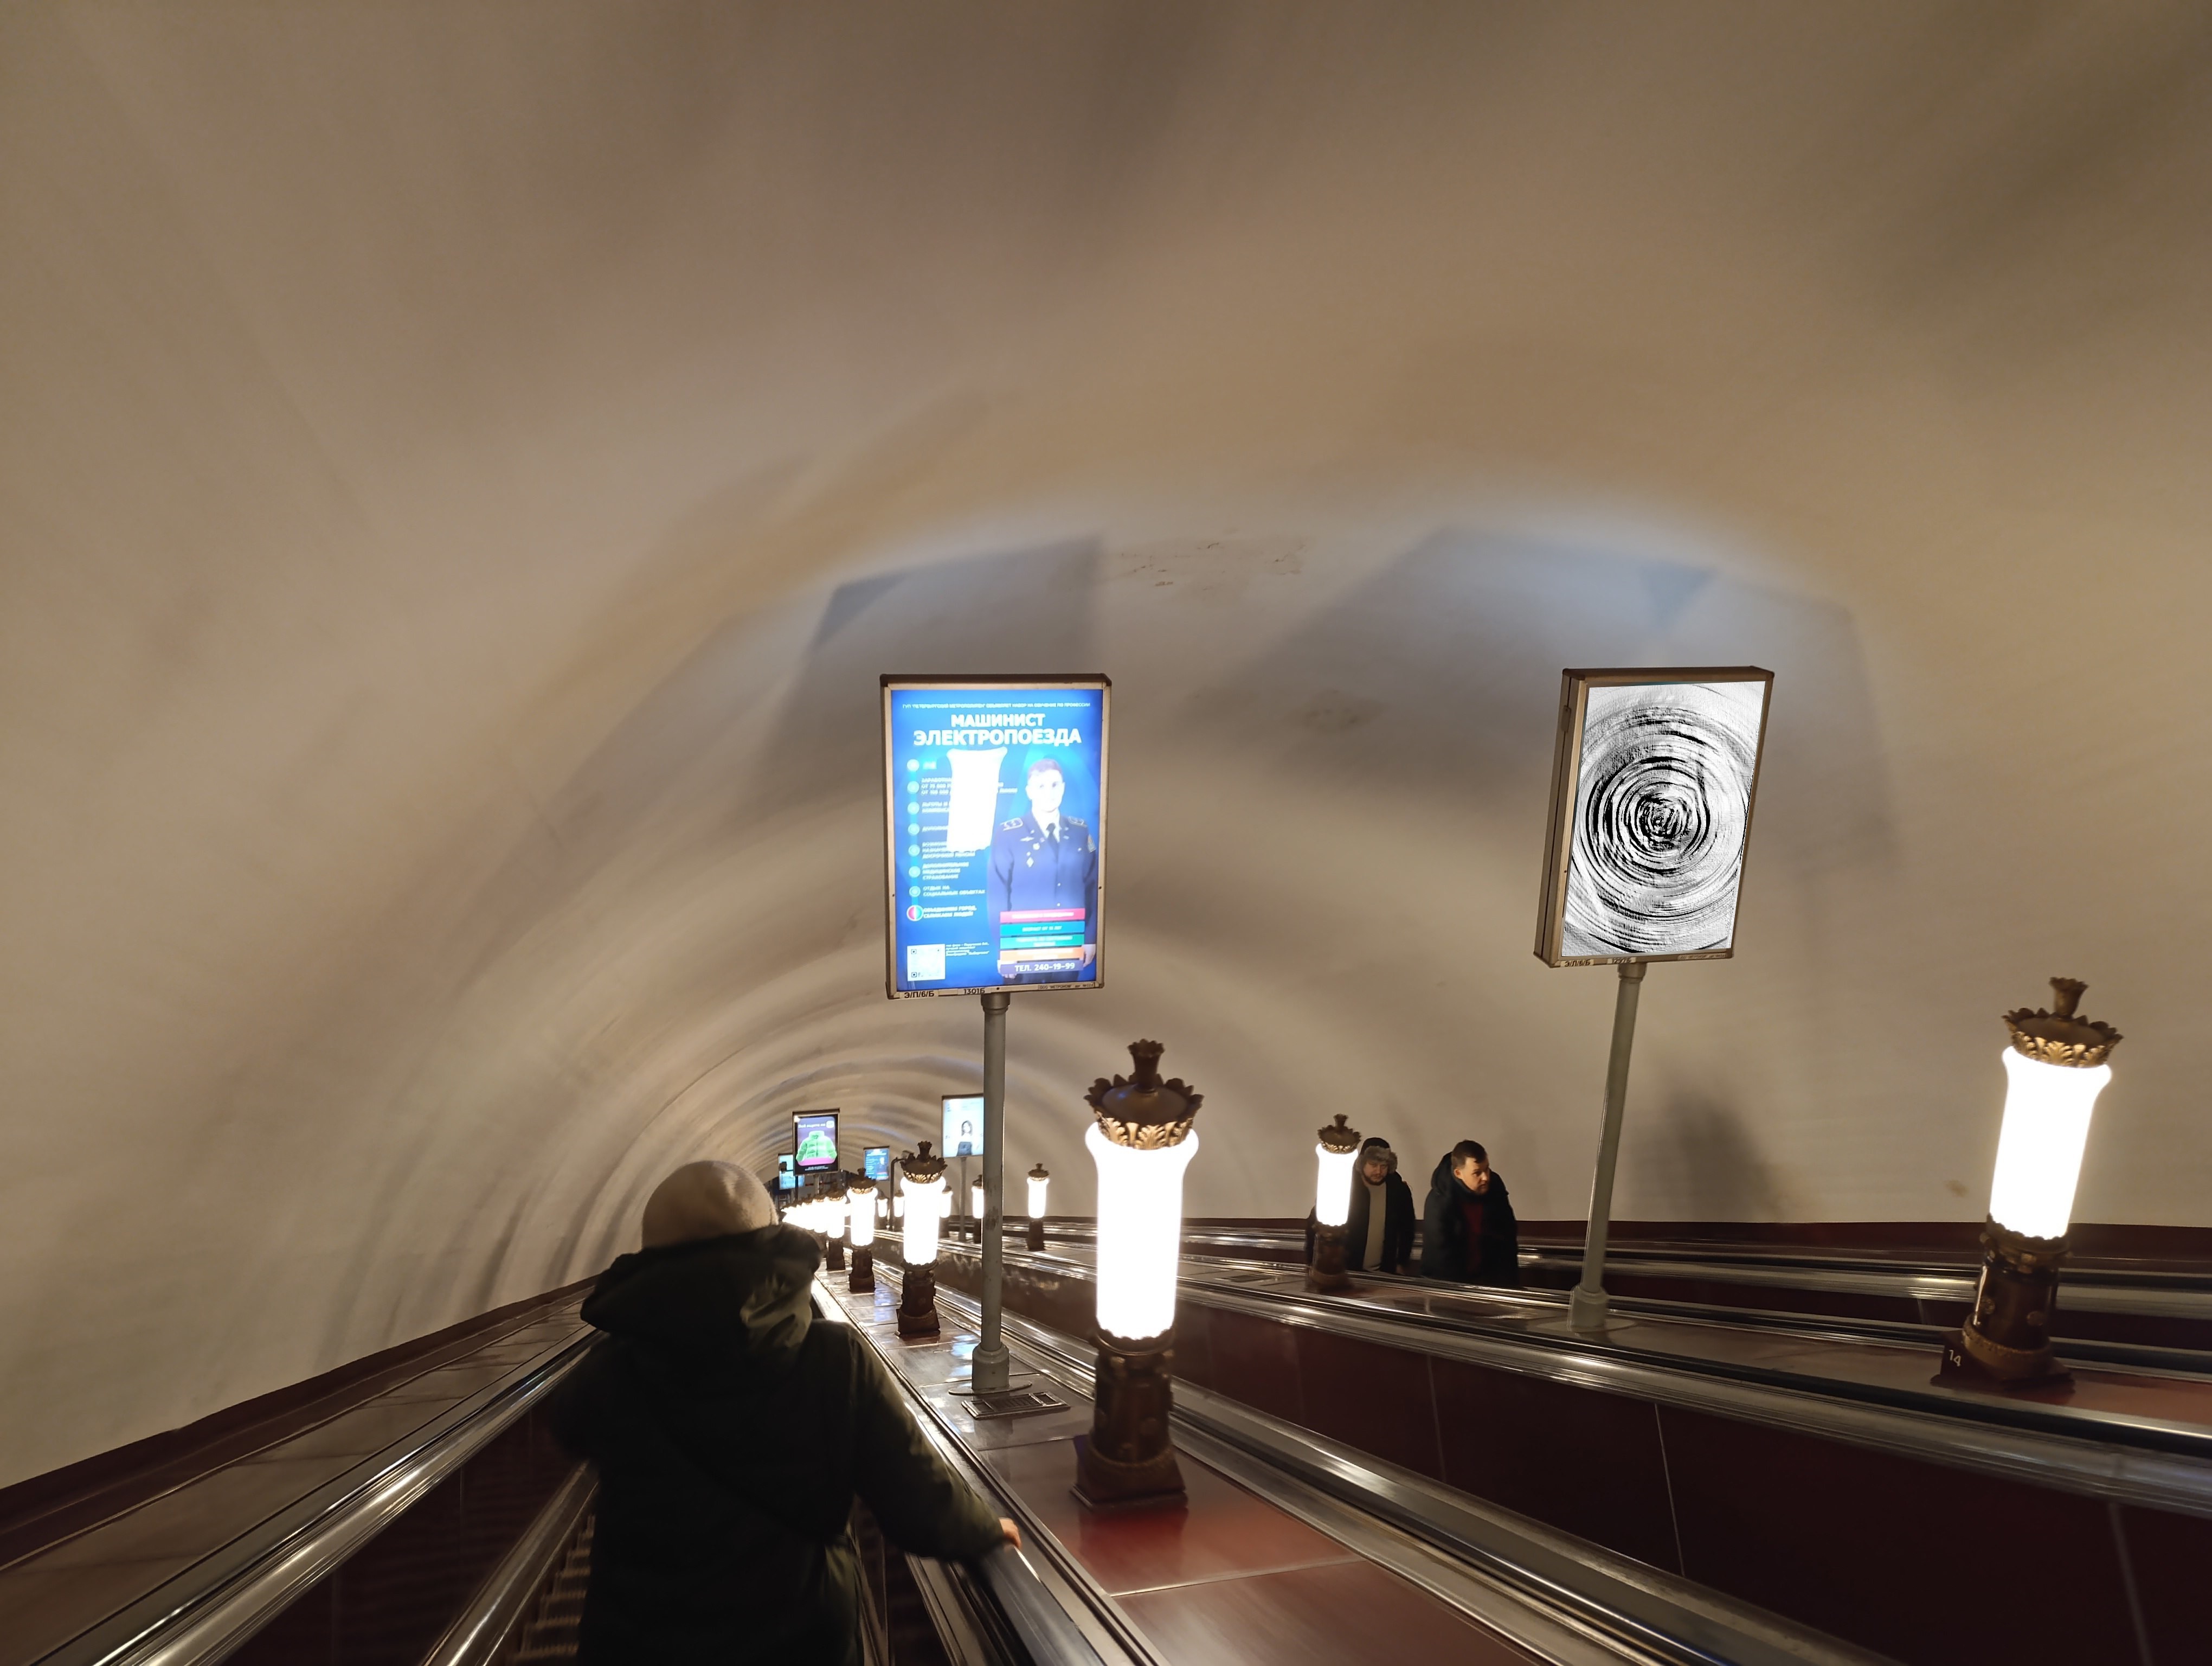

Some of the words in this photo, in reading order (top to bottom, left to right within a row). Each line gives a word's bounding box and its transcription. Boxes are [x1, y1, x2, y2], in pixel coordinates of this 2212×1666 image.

[951, 713, 1046, 727] МАШИНИСТ
[914, 728, 1082, 746] ЭЛЕКТРОПОЕЗДА
[1034, 963, 1075, 971] 240-19-99
[904, 990, 934, 998] Э/П/6/Б
[1949, 1349, 1961, 1367] 14
